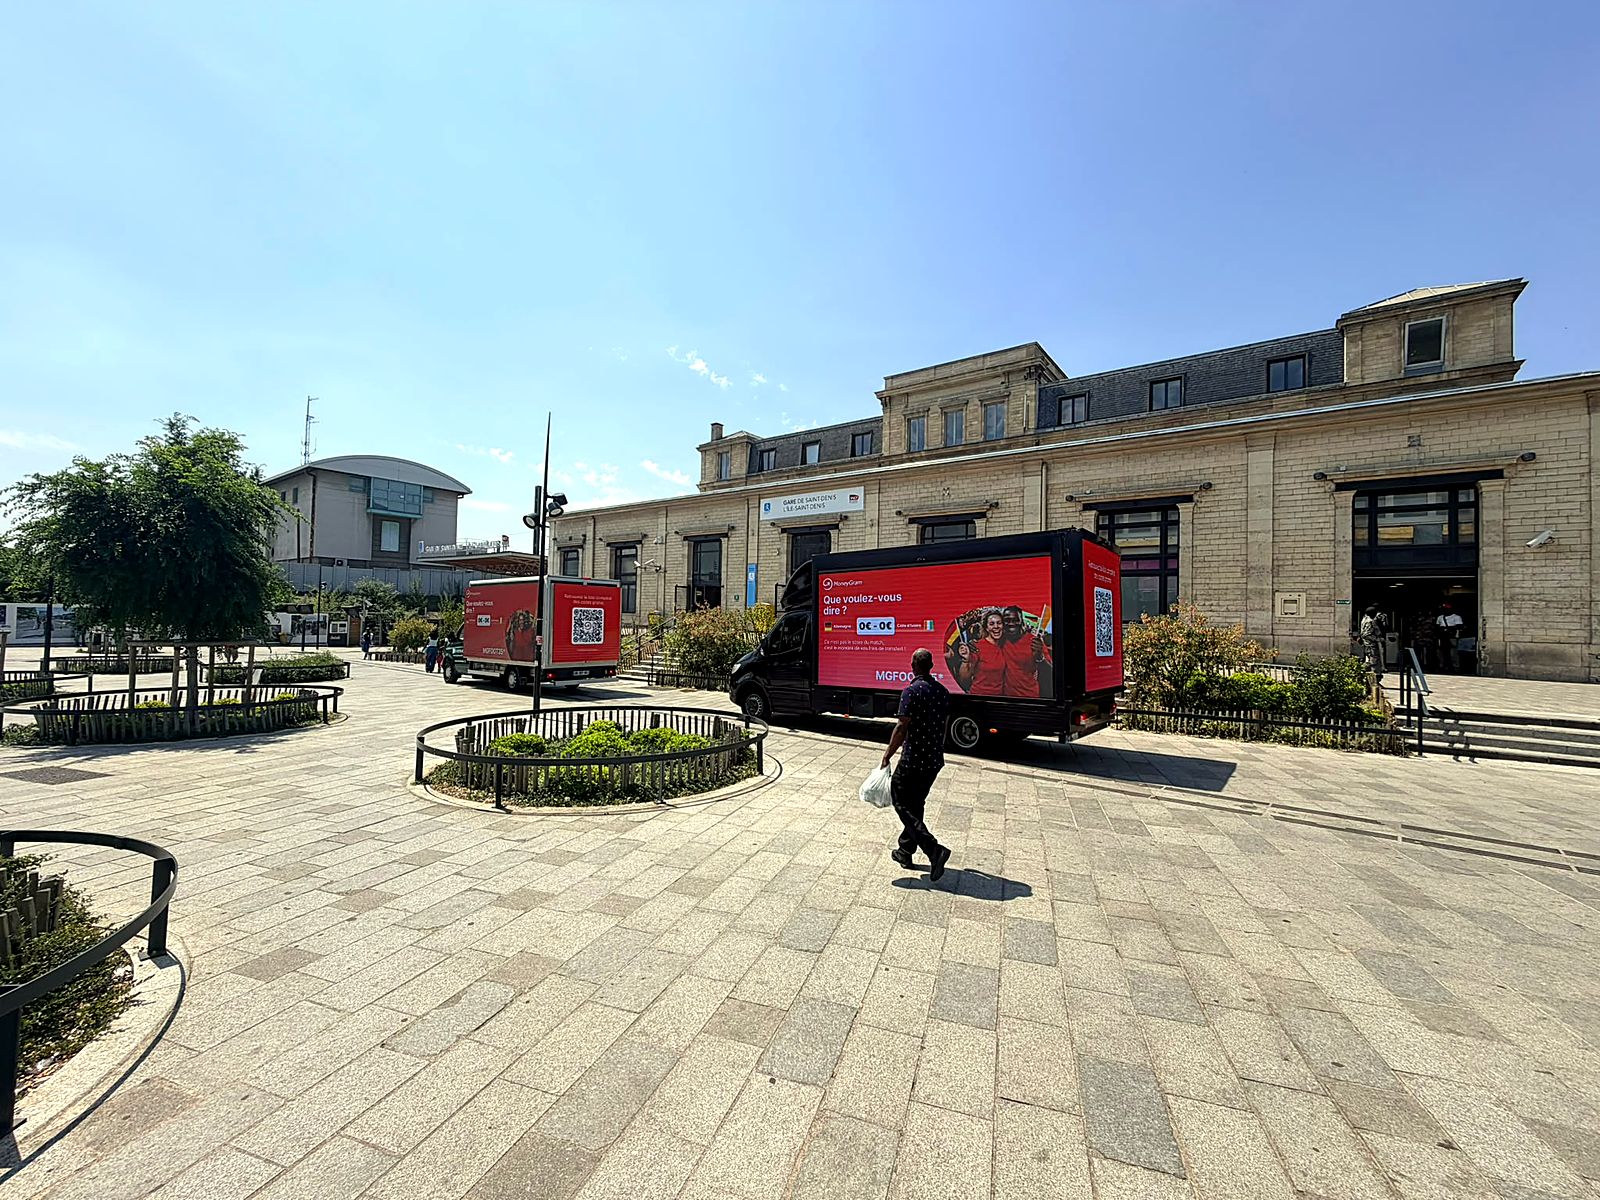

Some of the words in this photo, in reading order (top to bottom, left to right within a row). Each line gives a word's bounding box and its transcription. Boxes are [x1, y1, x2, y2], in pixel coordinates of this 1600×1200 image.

[823, 596, 841, 604] Que
[843, 593, 902, 604] voulez-vous
[823, 606, 840, 615] dire
[842, 606, 848, 614] ?
[859, 622, 872, 630] 0€
[879, 622, 892, 630] 0€
